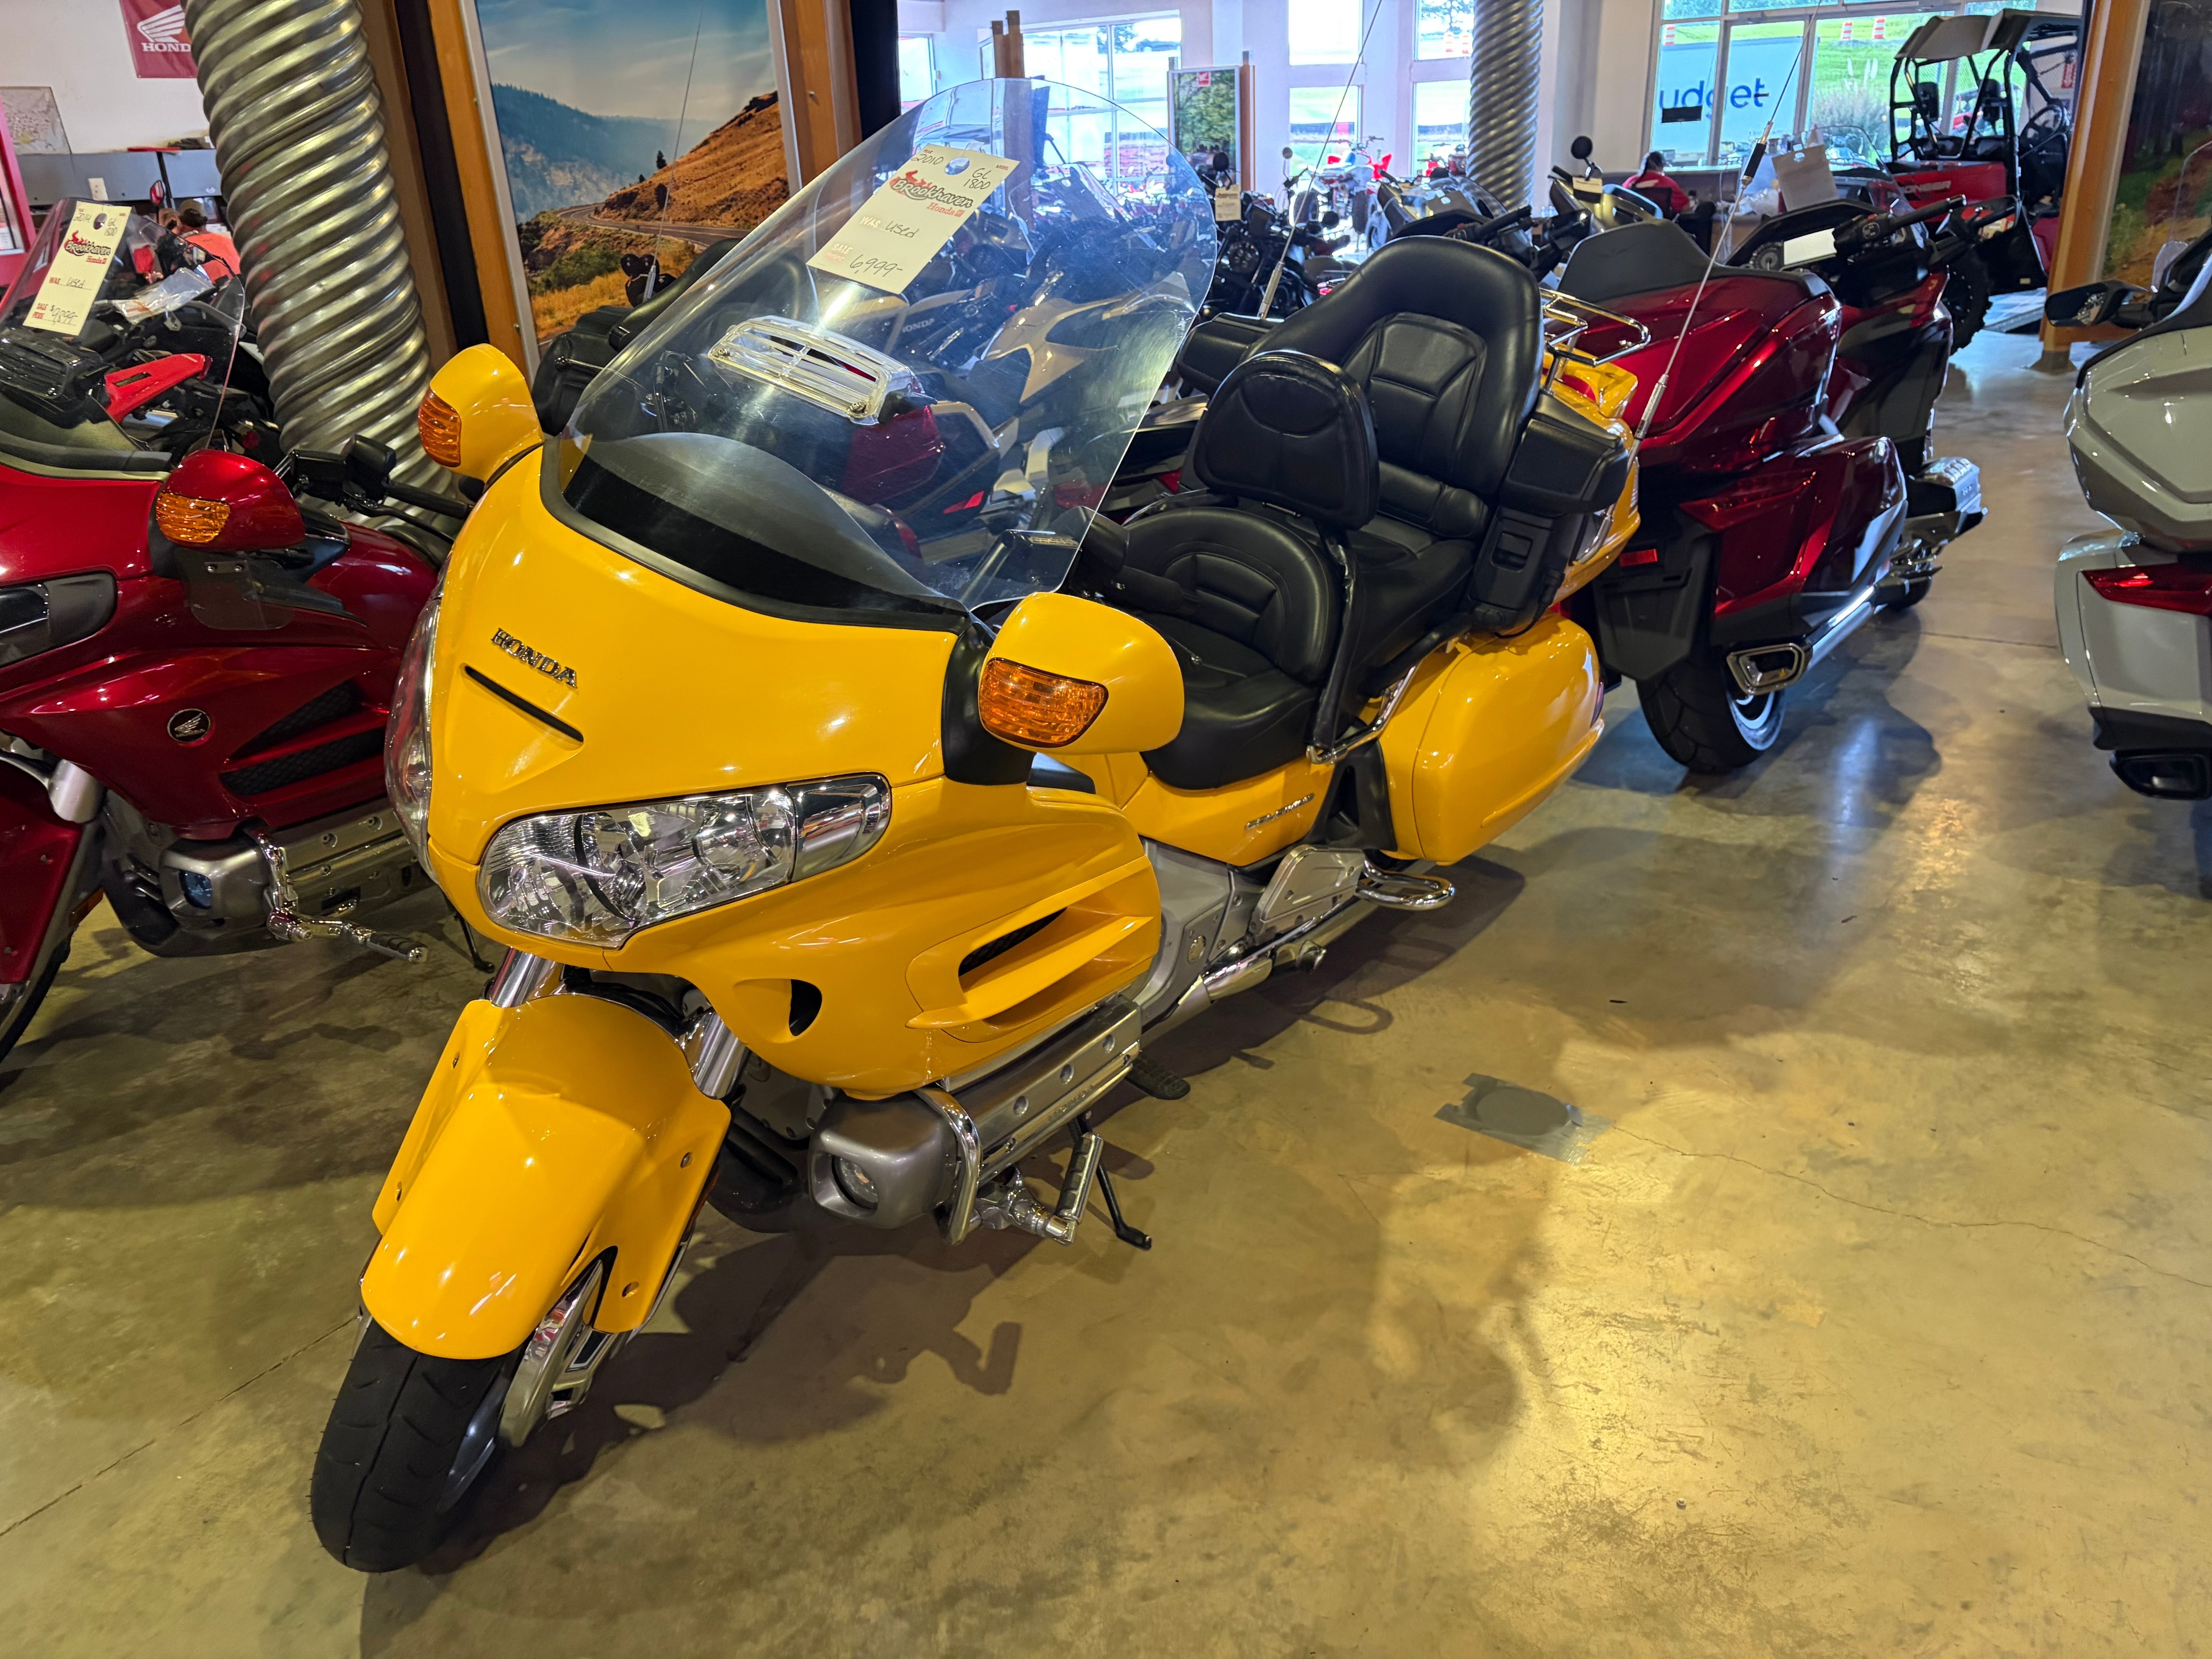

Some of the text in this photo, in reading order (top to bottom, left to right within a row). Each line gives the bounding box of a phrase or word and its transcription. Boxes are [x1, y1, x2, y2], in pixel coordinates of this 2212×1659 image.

[141, 43, 191, 52] HOND
[1659, 78, 1765, 119] udet
[910, 154, 944, 165] 2010
[963, 179, 991, 190] 1800
[927, 202, 956, 215] Honda
[859, 216, 881, 228] WAS
[831, 243, 853, 254] SALE
[902, 318, 935, 333] ONDA
[491, 627, 578, 689] HONDA
